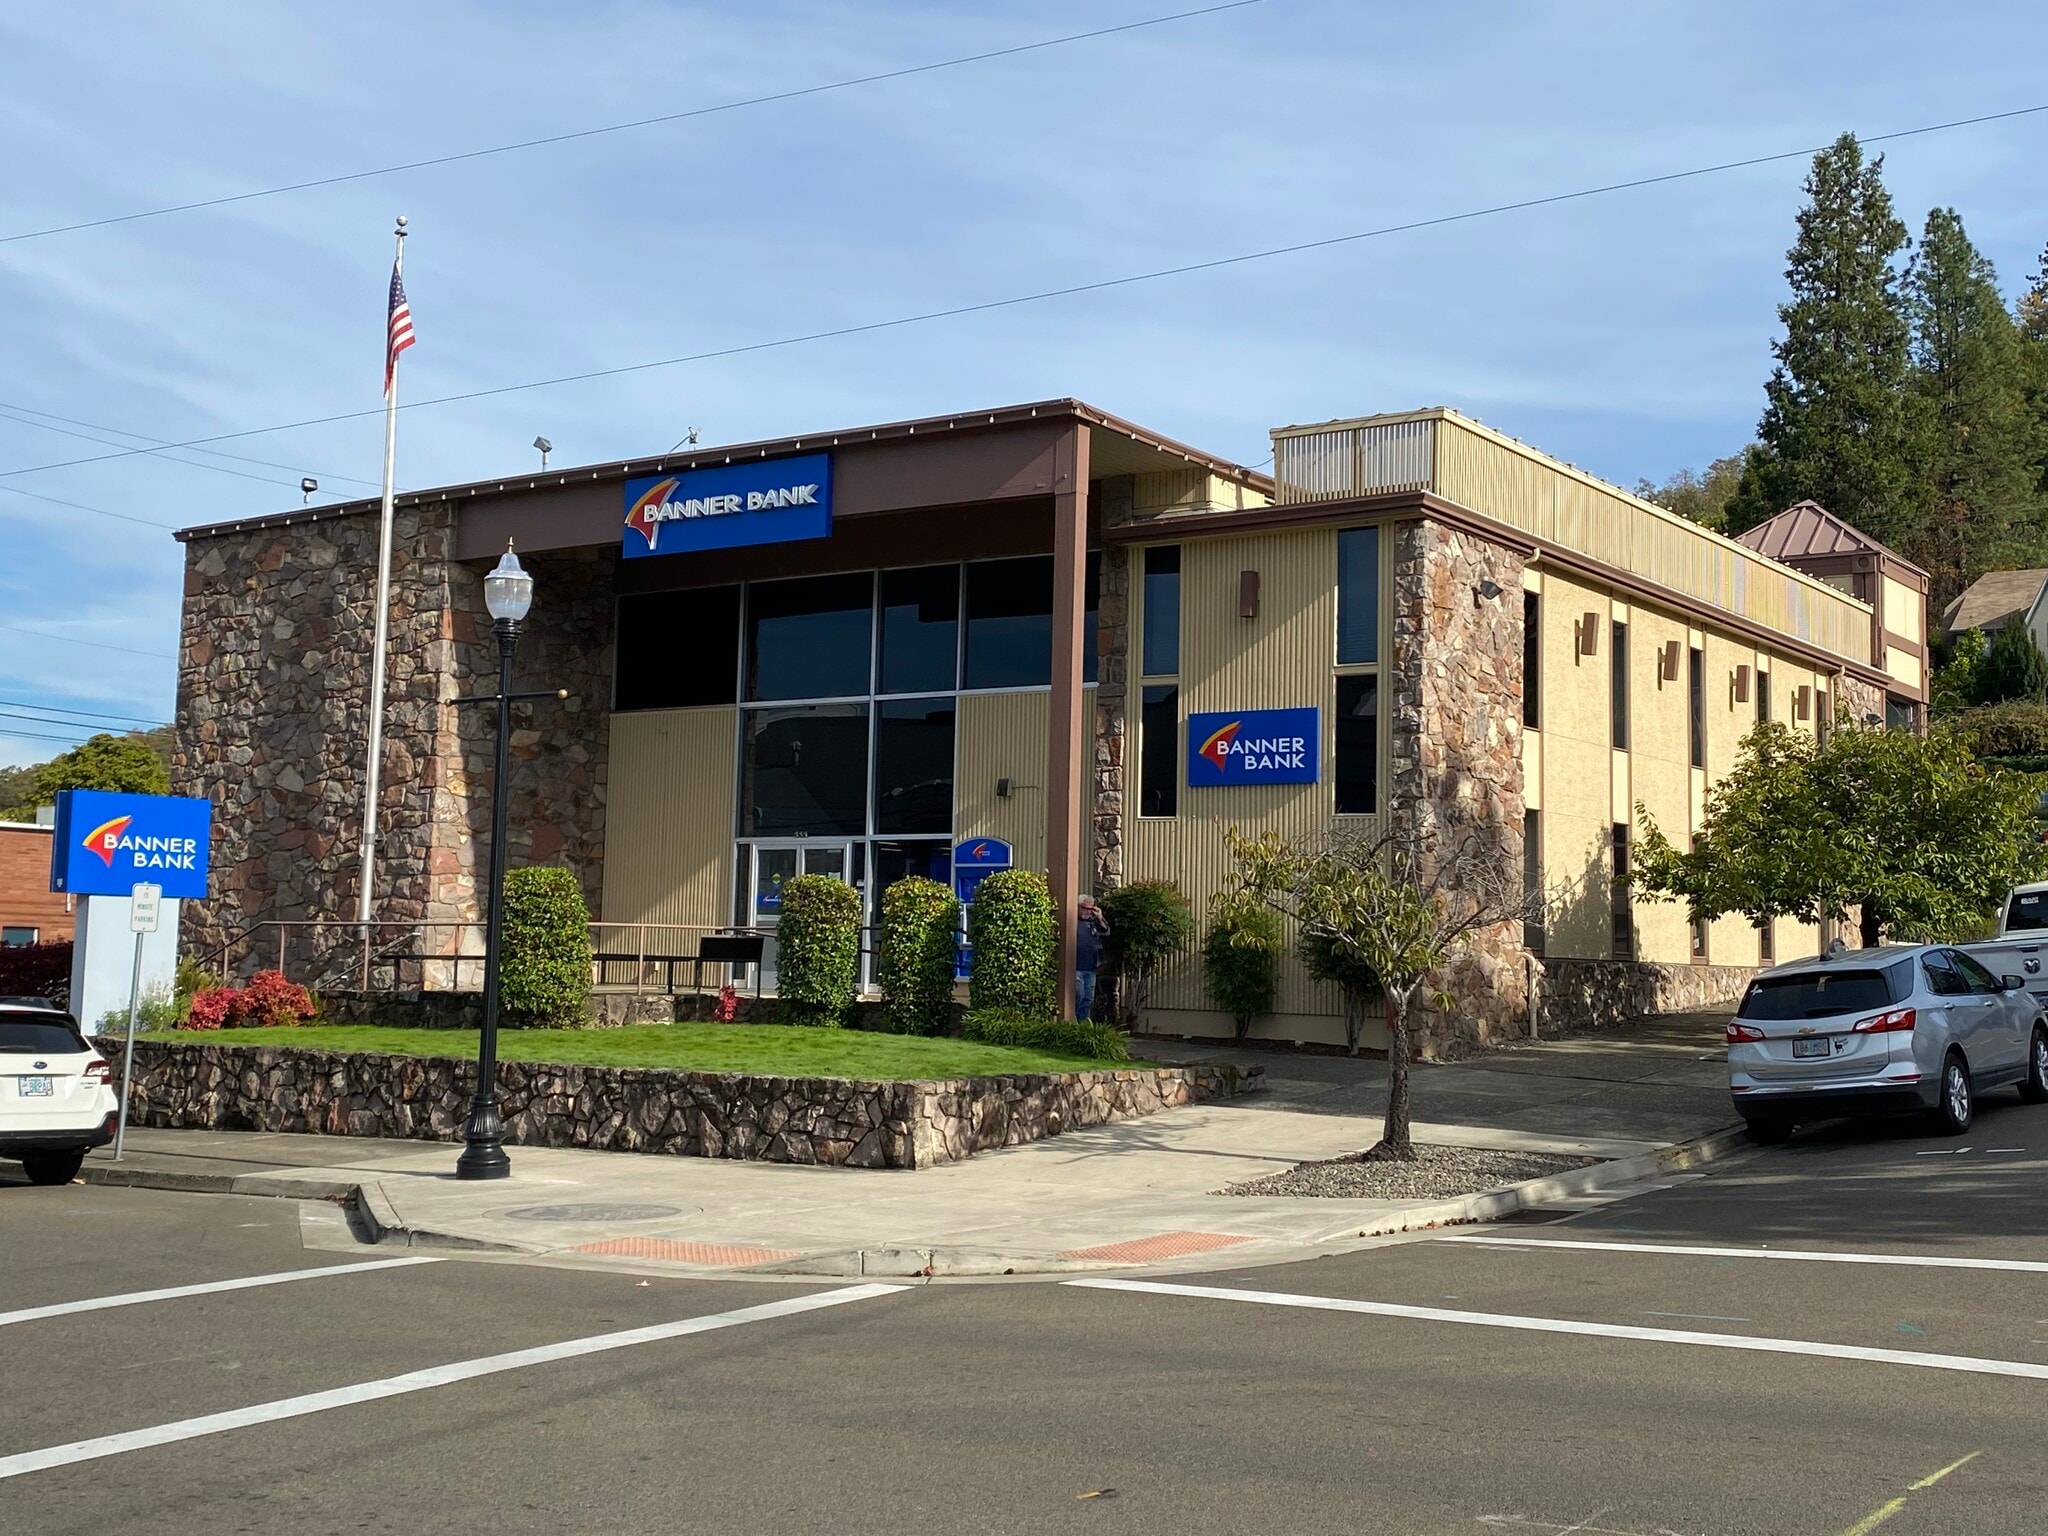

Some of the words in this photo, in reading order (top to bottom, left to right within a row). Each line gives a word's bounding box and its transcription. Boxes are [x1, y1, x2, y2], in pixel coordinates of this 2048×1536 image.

[643, 494, 744, 523] BANNER
[747, 483, 819, 511] BANK
[1217, 738, 1305, 755] BANNER
[1245, 753, 1305, 769] BANK
[104, 833, 196, 854] BANNER
[134, 852, 195, 870] BANK
